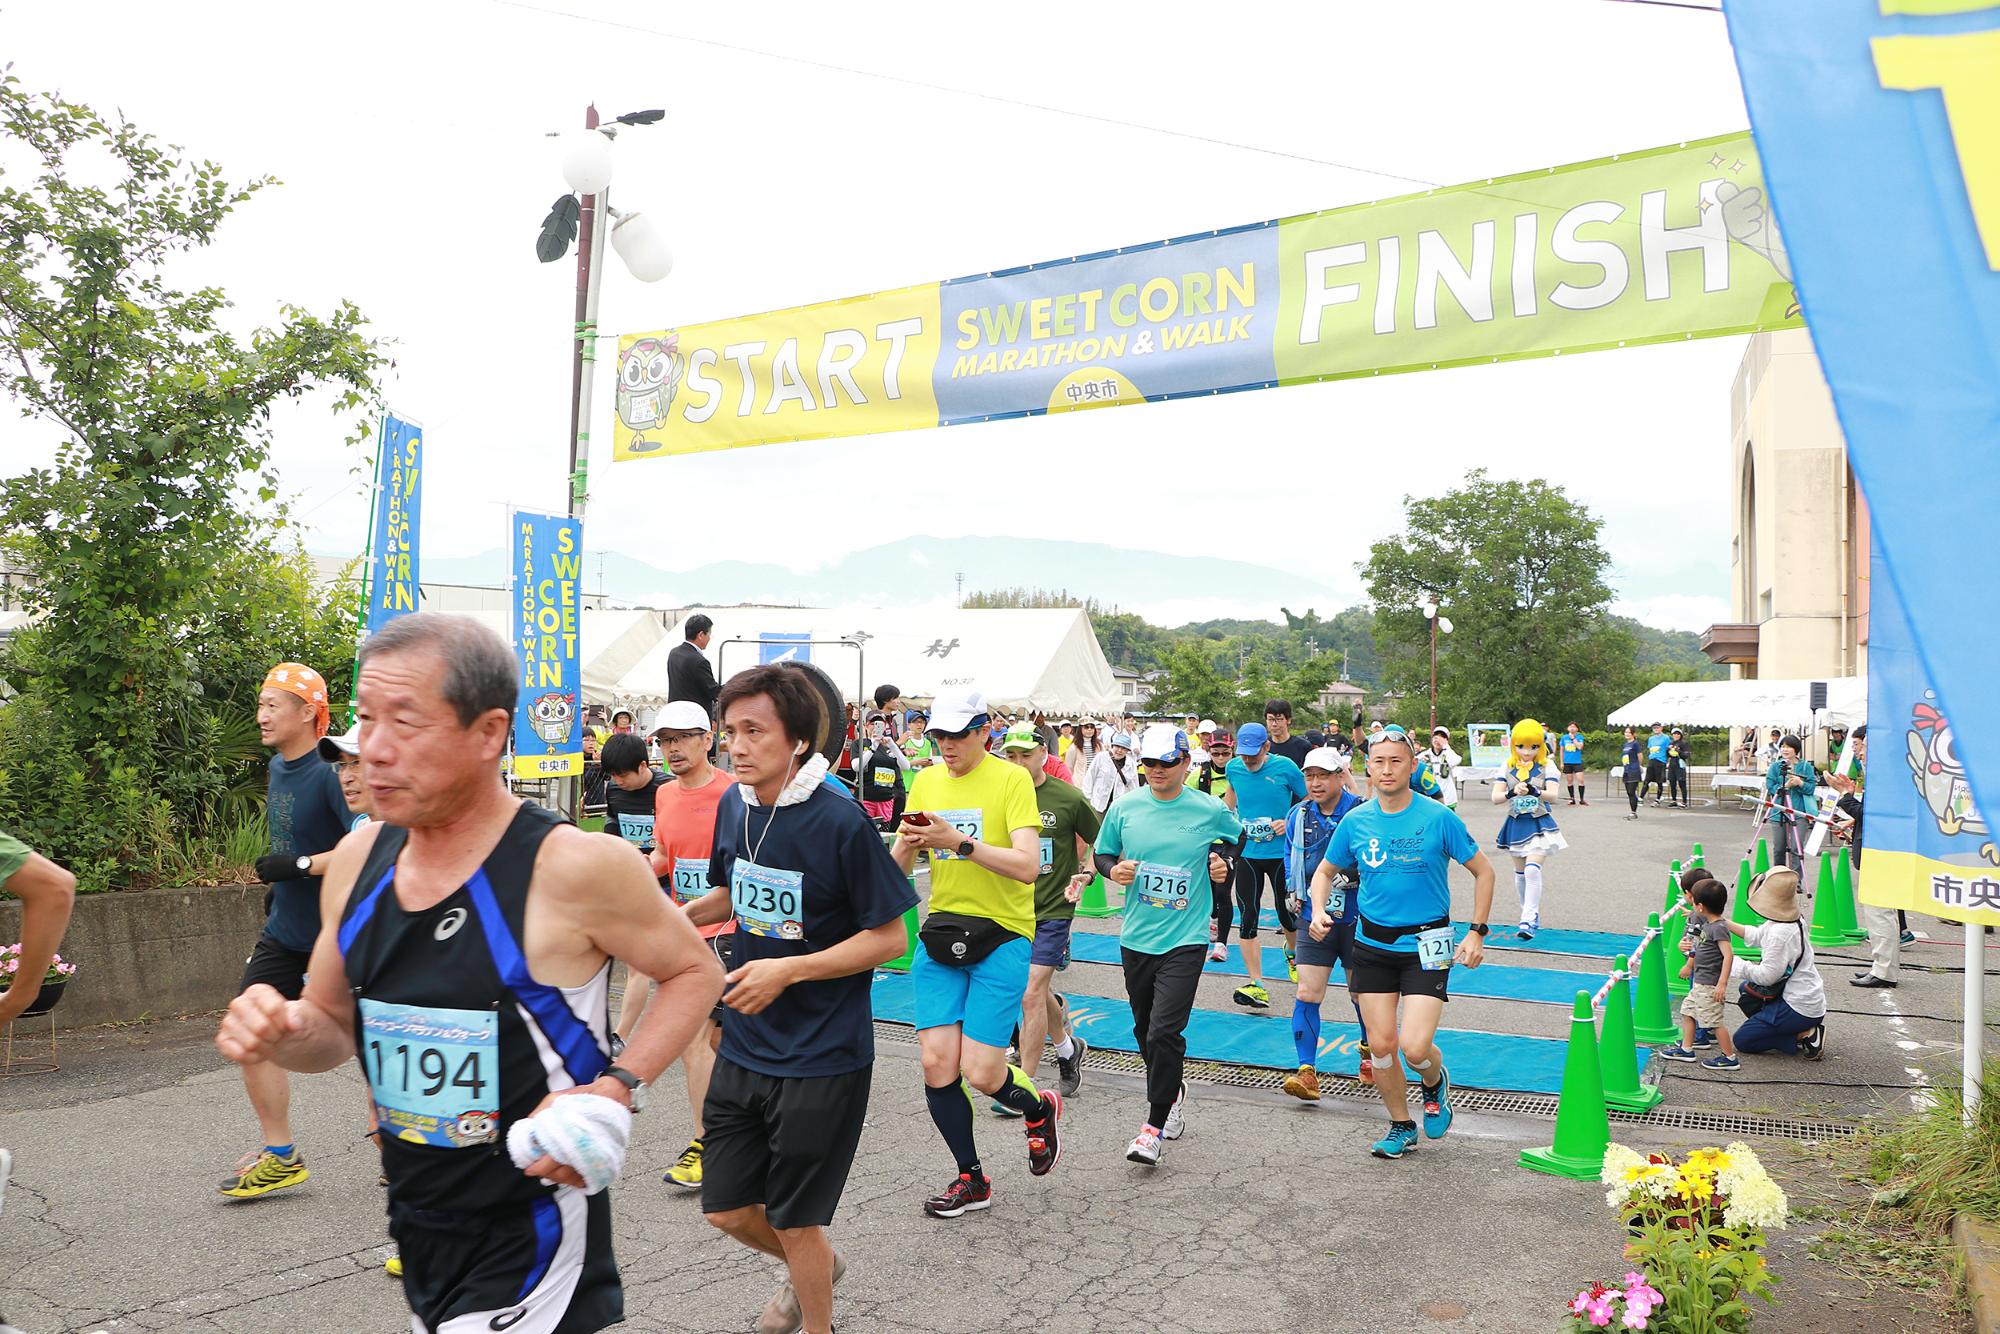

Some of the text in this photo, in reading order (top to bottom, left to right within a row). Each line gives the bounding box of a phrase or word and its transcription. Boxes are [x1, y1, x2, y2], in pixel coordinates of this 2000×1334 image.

[1298, 177, 1730, 345] FINISH
[955, 262, 1256, 351] SWEET CORN
[683, 316, 923, 424] START
[951, 314, 1254, 379] MARATHON & WALK
[1066, 379, 1118, 402] 中央市
[383, 553, 398, 609] WALK
[521, 522, 537, 688] MARATHON & WALK
[537, 527, 580, 688] SWEET CORN
[539, 760, 569, 771] 中央市
[622, 823, 653, 837] 1279
[1245, 824, 1271, 835] 1286
[735, 880, 796, 915] 1230
[1143, 874, 1188, 896] 1216
[370, 1040, 487, 1100] 1194
